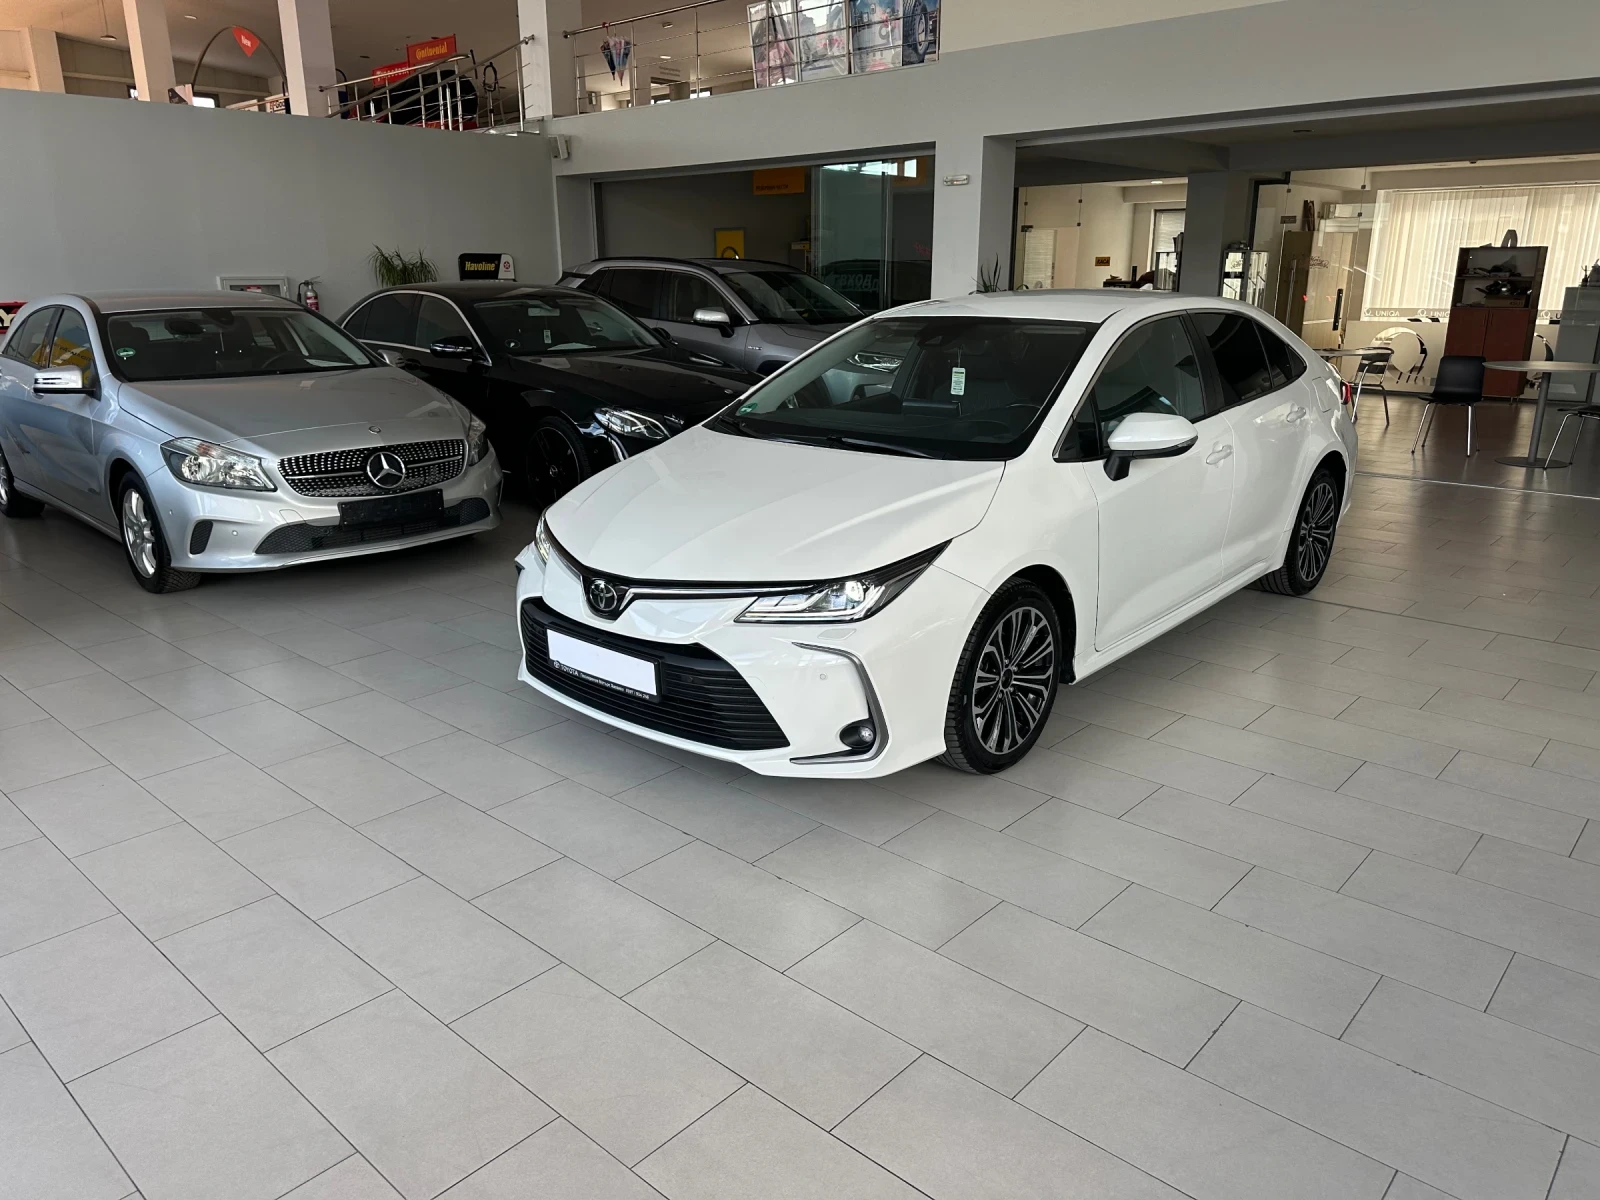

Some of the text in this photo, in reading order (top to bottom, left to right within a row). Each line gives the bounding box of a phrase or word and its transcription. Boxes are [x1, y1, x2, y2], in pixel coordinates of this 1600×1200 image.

[416, 40, 448, 60] Continental
[465, 261, 496, 271] Havoline
[560, 664, 579, 677] TOYOTA
